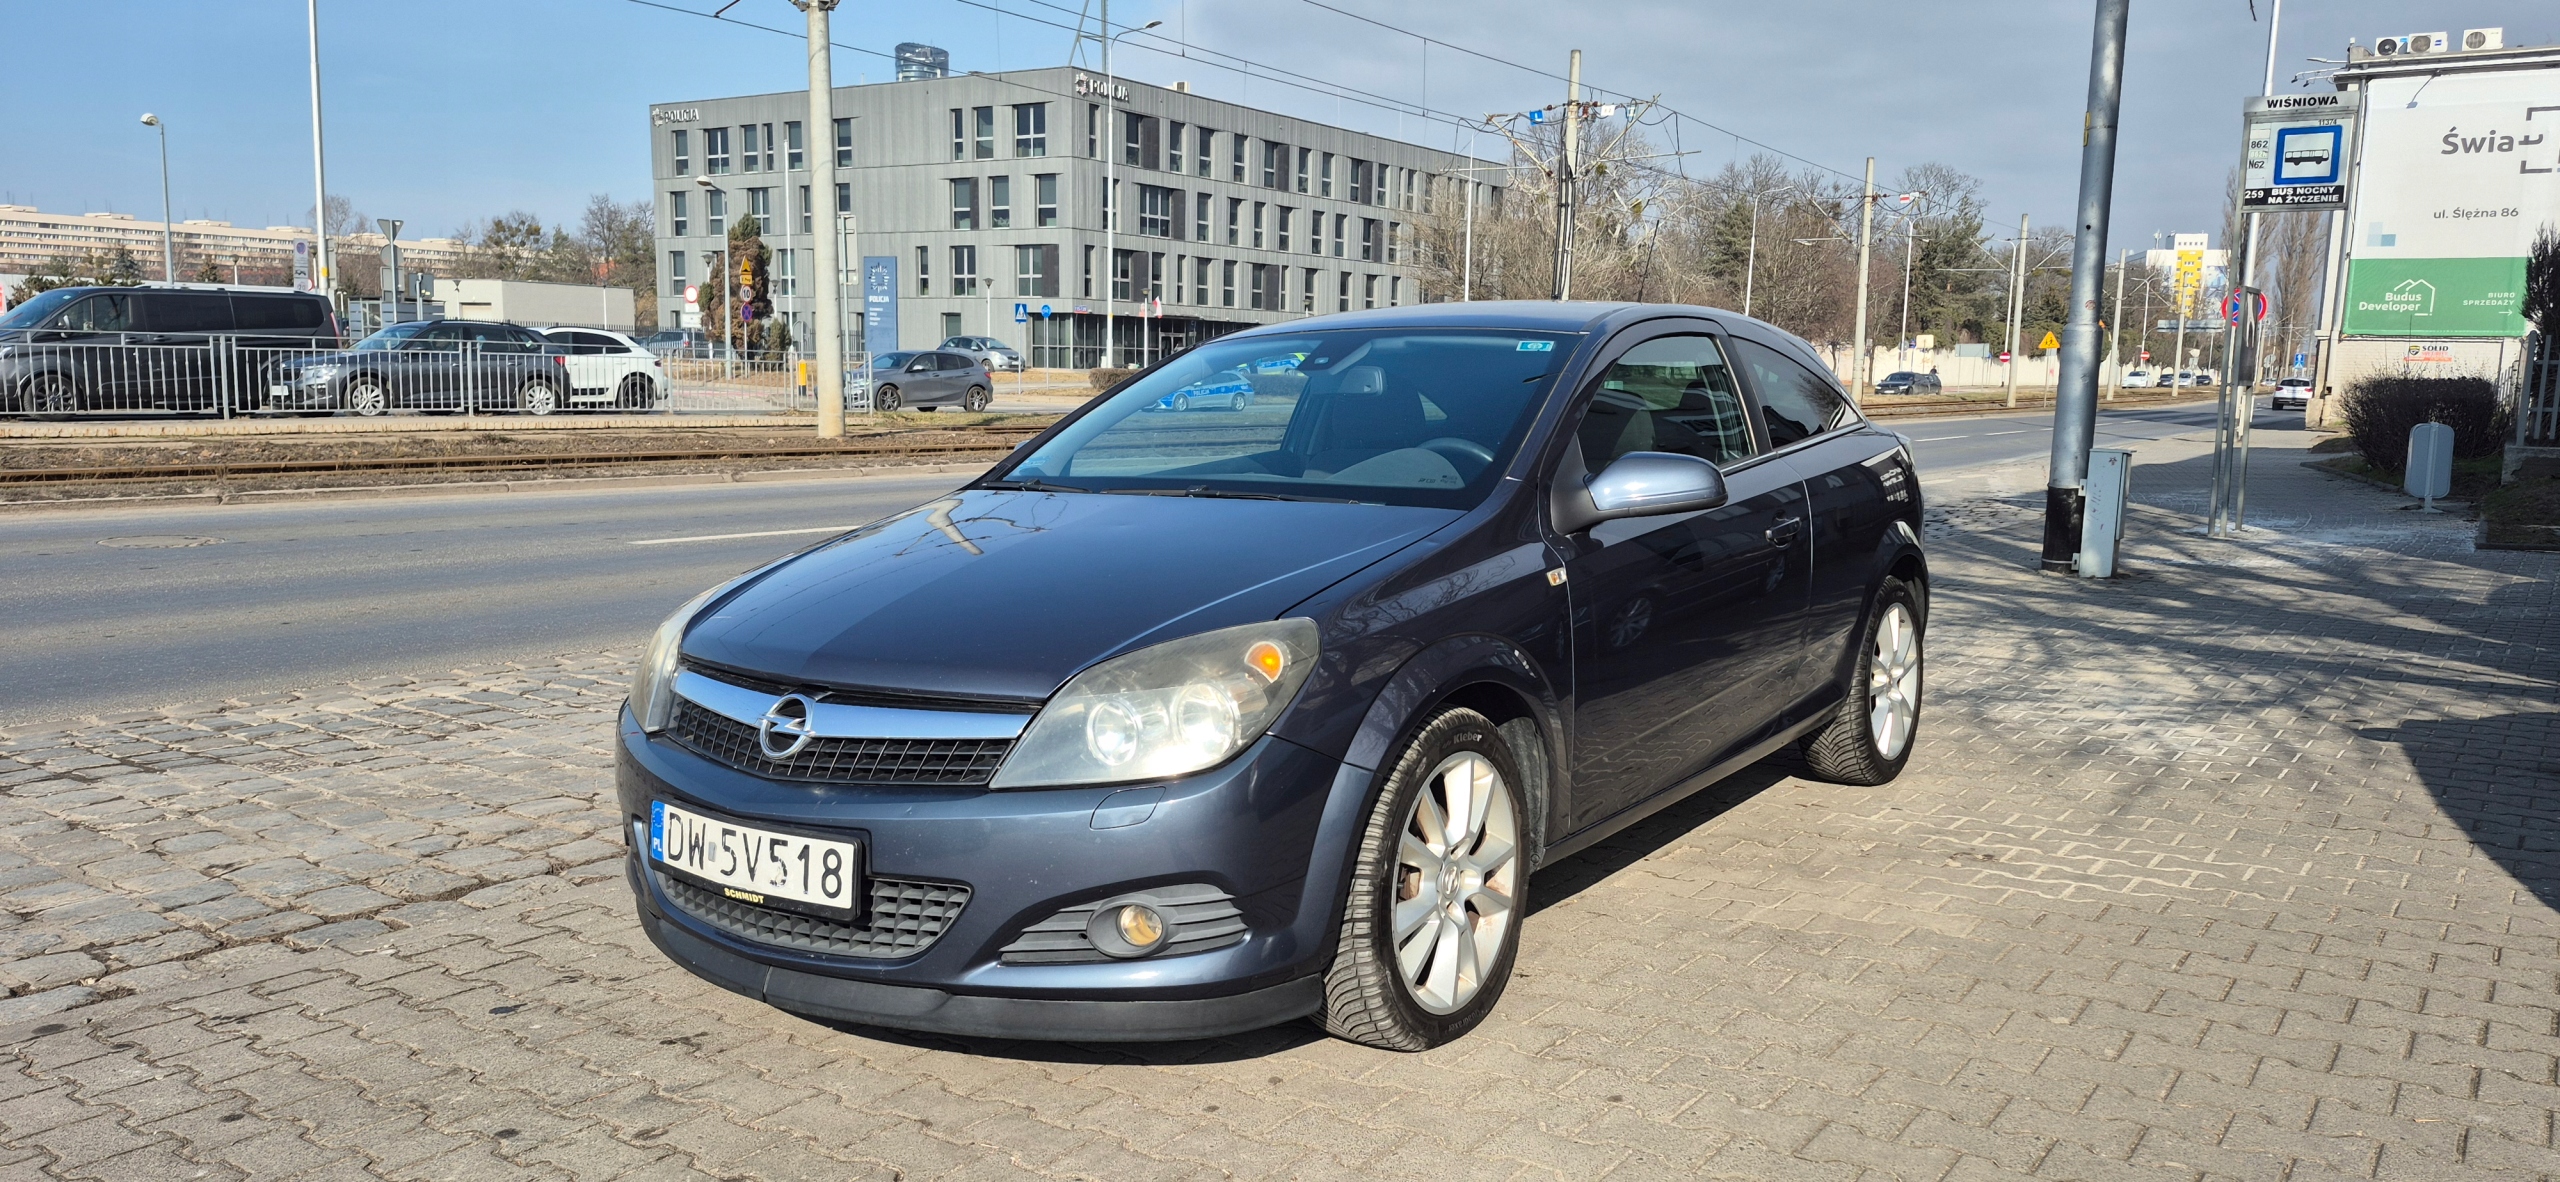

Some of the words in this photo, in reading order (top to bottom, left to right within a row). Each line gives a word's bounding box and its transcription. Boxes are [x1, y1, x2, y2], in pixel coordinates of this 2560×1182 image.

[2267, 96, 2339, 109] WIŚNIOWA
[664, 108, 700, 123] POLICJA
[2251, 140, 2269, 149] 862
[2248, 160, 2265, 169] N62
[2244, 190, 2265, 199] 259
[2271, 187, 2294, 196] BUS
[2296, 186, 2336, 195] NOCNY
[2267, 196, 2283, 204] NA
[2285, 194, 2340, 203] ŻYCZENIE
[2433, 209, 2449, 219] ul.
[2452, 206, 2497, 220] Ślężna
[2500, 207, 2519, 217] 86
[868, 295, 890, 303] POLICJA
[2384, 292, 2422, 301] Budus
[2358, 301, 2421, 313] Developer
[1453, 731, 1482, 744] Kleber
[653, 837, 663, 852] PL
[667, 811, 707, 870] DW
[720, 827, 843, 899] 5V518
[724, 887, 765, 904] SCHMIDT
